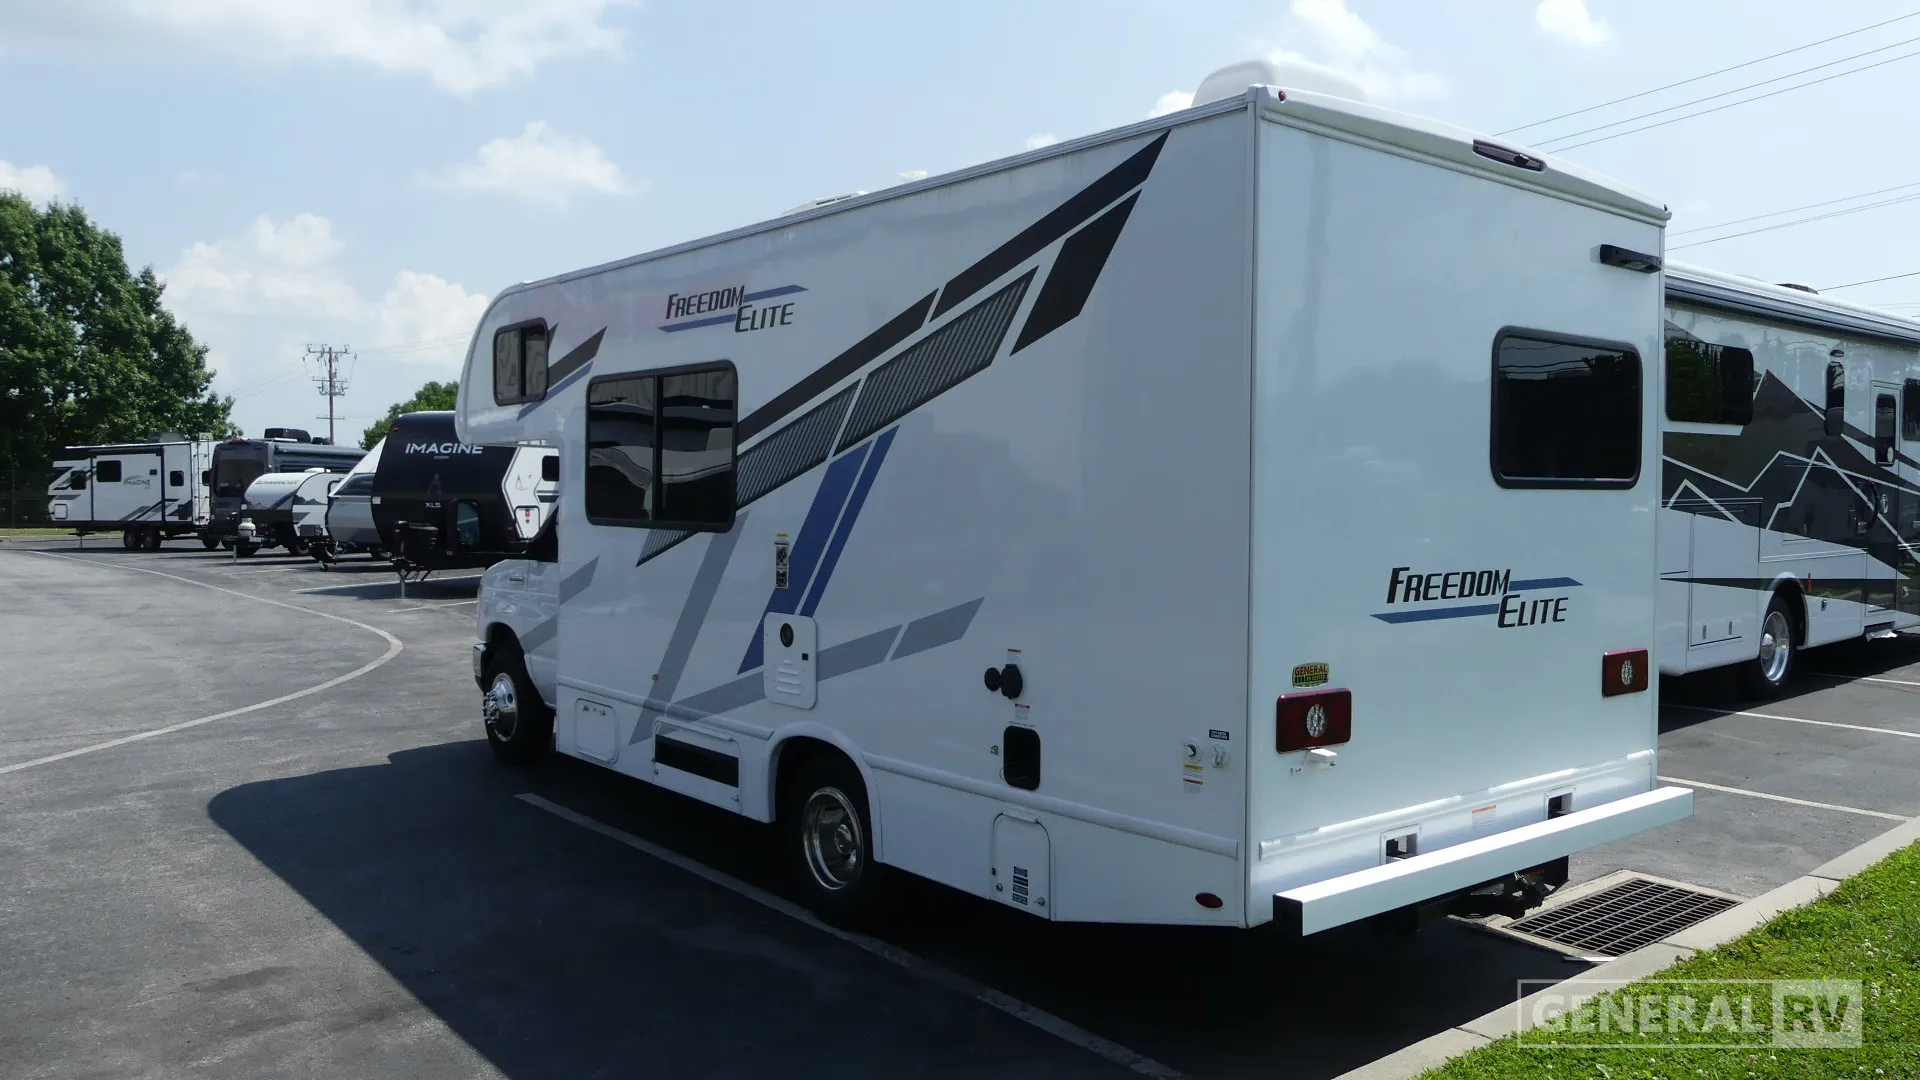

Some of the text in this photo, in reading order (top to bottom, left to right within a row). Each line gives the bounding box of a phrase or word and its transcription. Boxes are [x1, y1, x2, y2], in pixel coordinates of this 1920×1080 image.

[665, 285, 745, 320] FREEDOM
[735, 302, 795, 333] ELITE
[405, 443, 484, 454] IMAGINE
[1386, 567, 1511, 604] FREEDOM
[1497, 594, 1569, 628] ELITE
[1294, 664, 1327, 676] GENERAL
